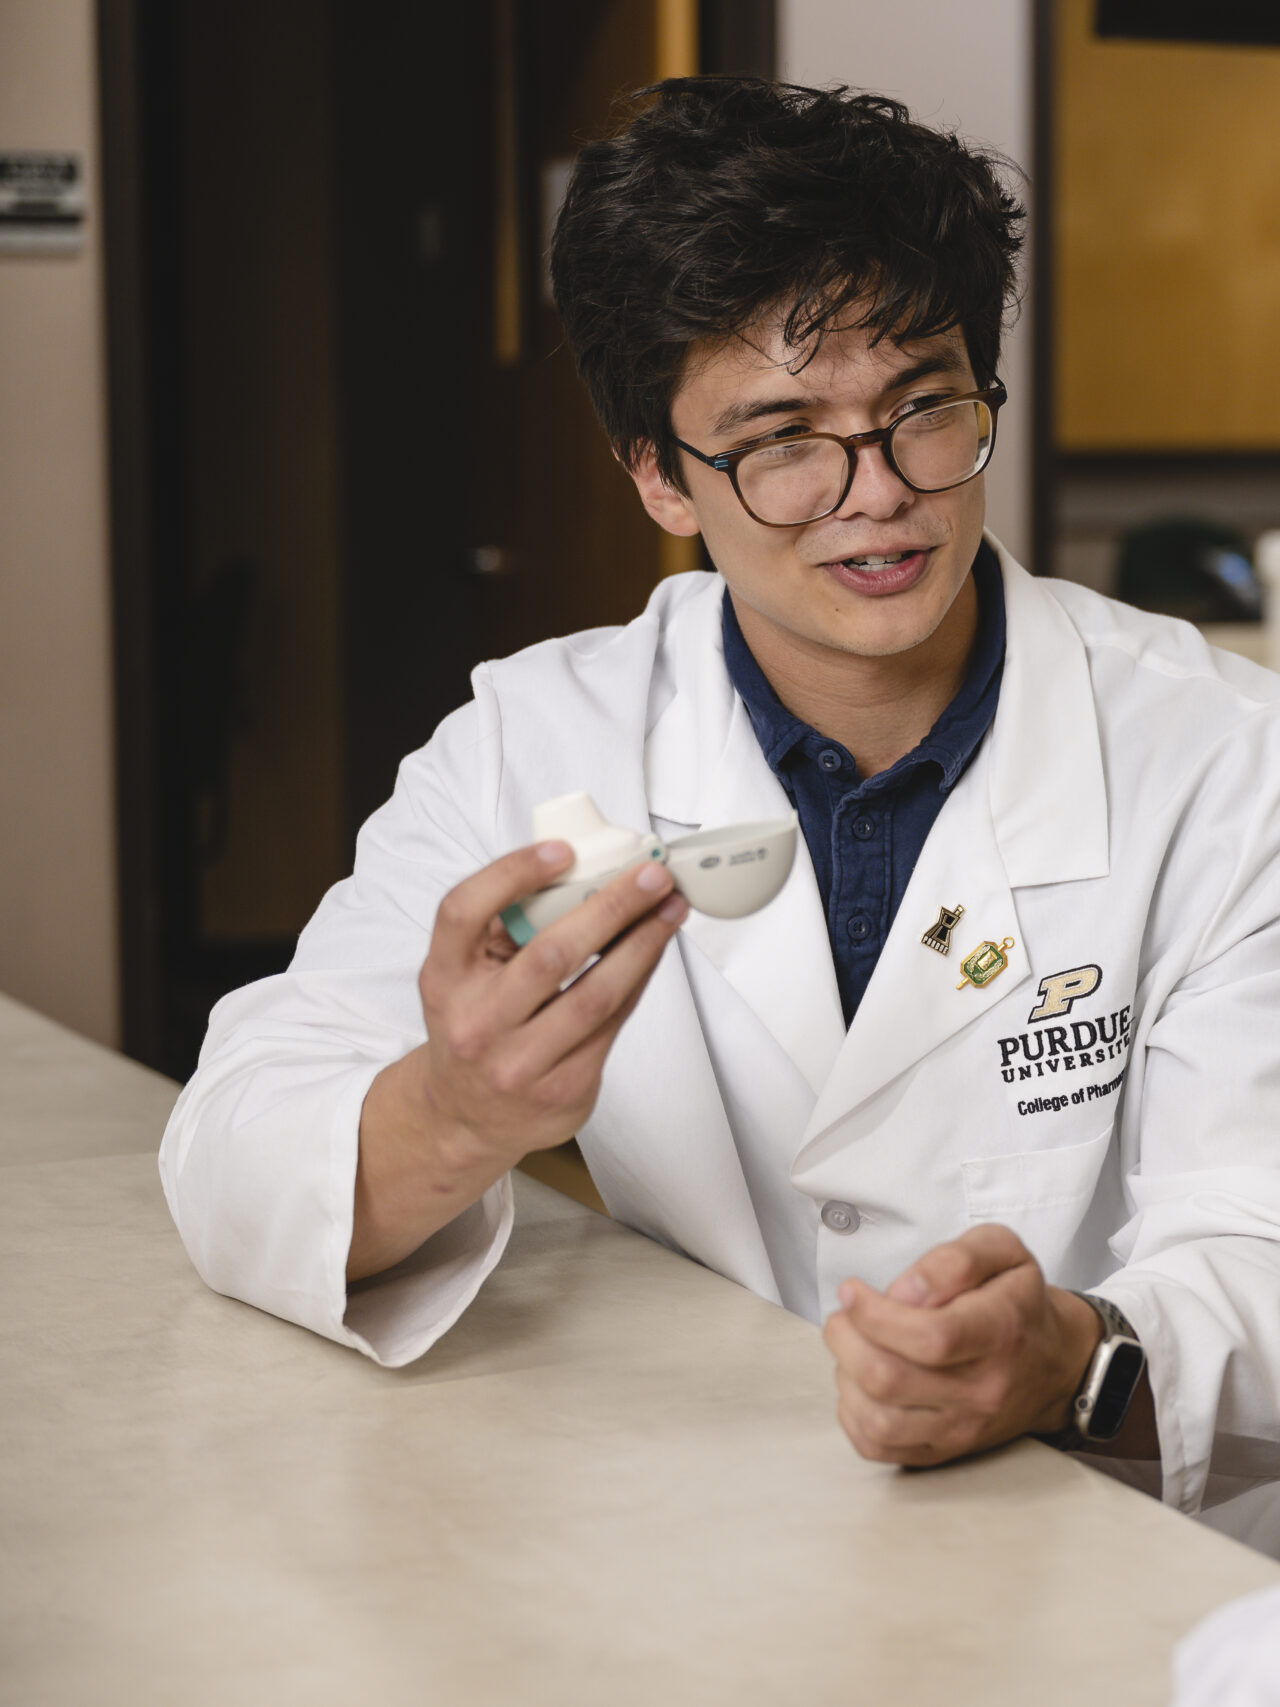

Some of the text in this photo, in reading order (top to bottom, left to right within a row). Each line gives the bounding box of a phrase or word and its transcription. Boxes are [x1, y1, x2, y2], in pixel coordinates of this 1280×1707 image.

[1028, 964, 1103, 1024] P
[998, 1005, 1131, 1067] PURDUE
[1018, 1095, 1069, 1116] College
[1071, 1088, 1085, 1104] of
